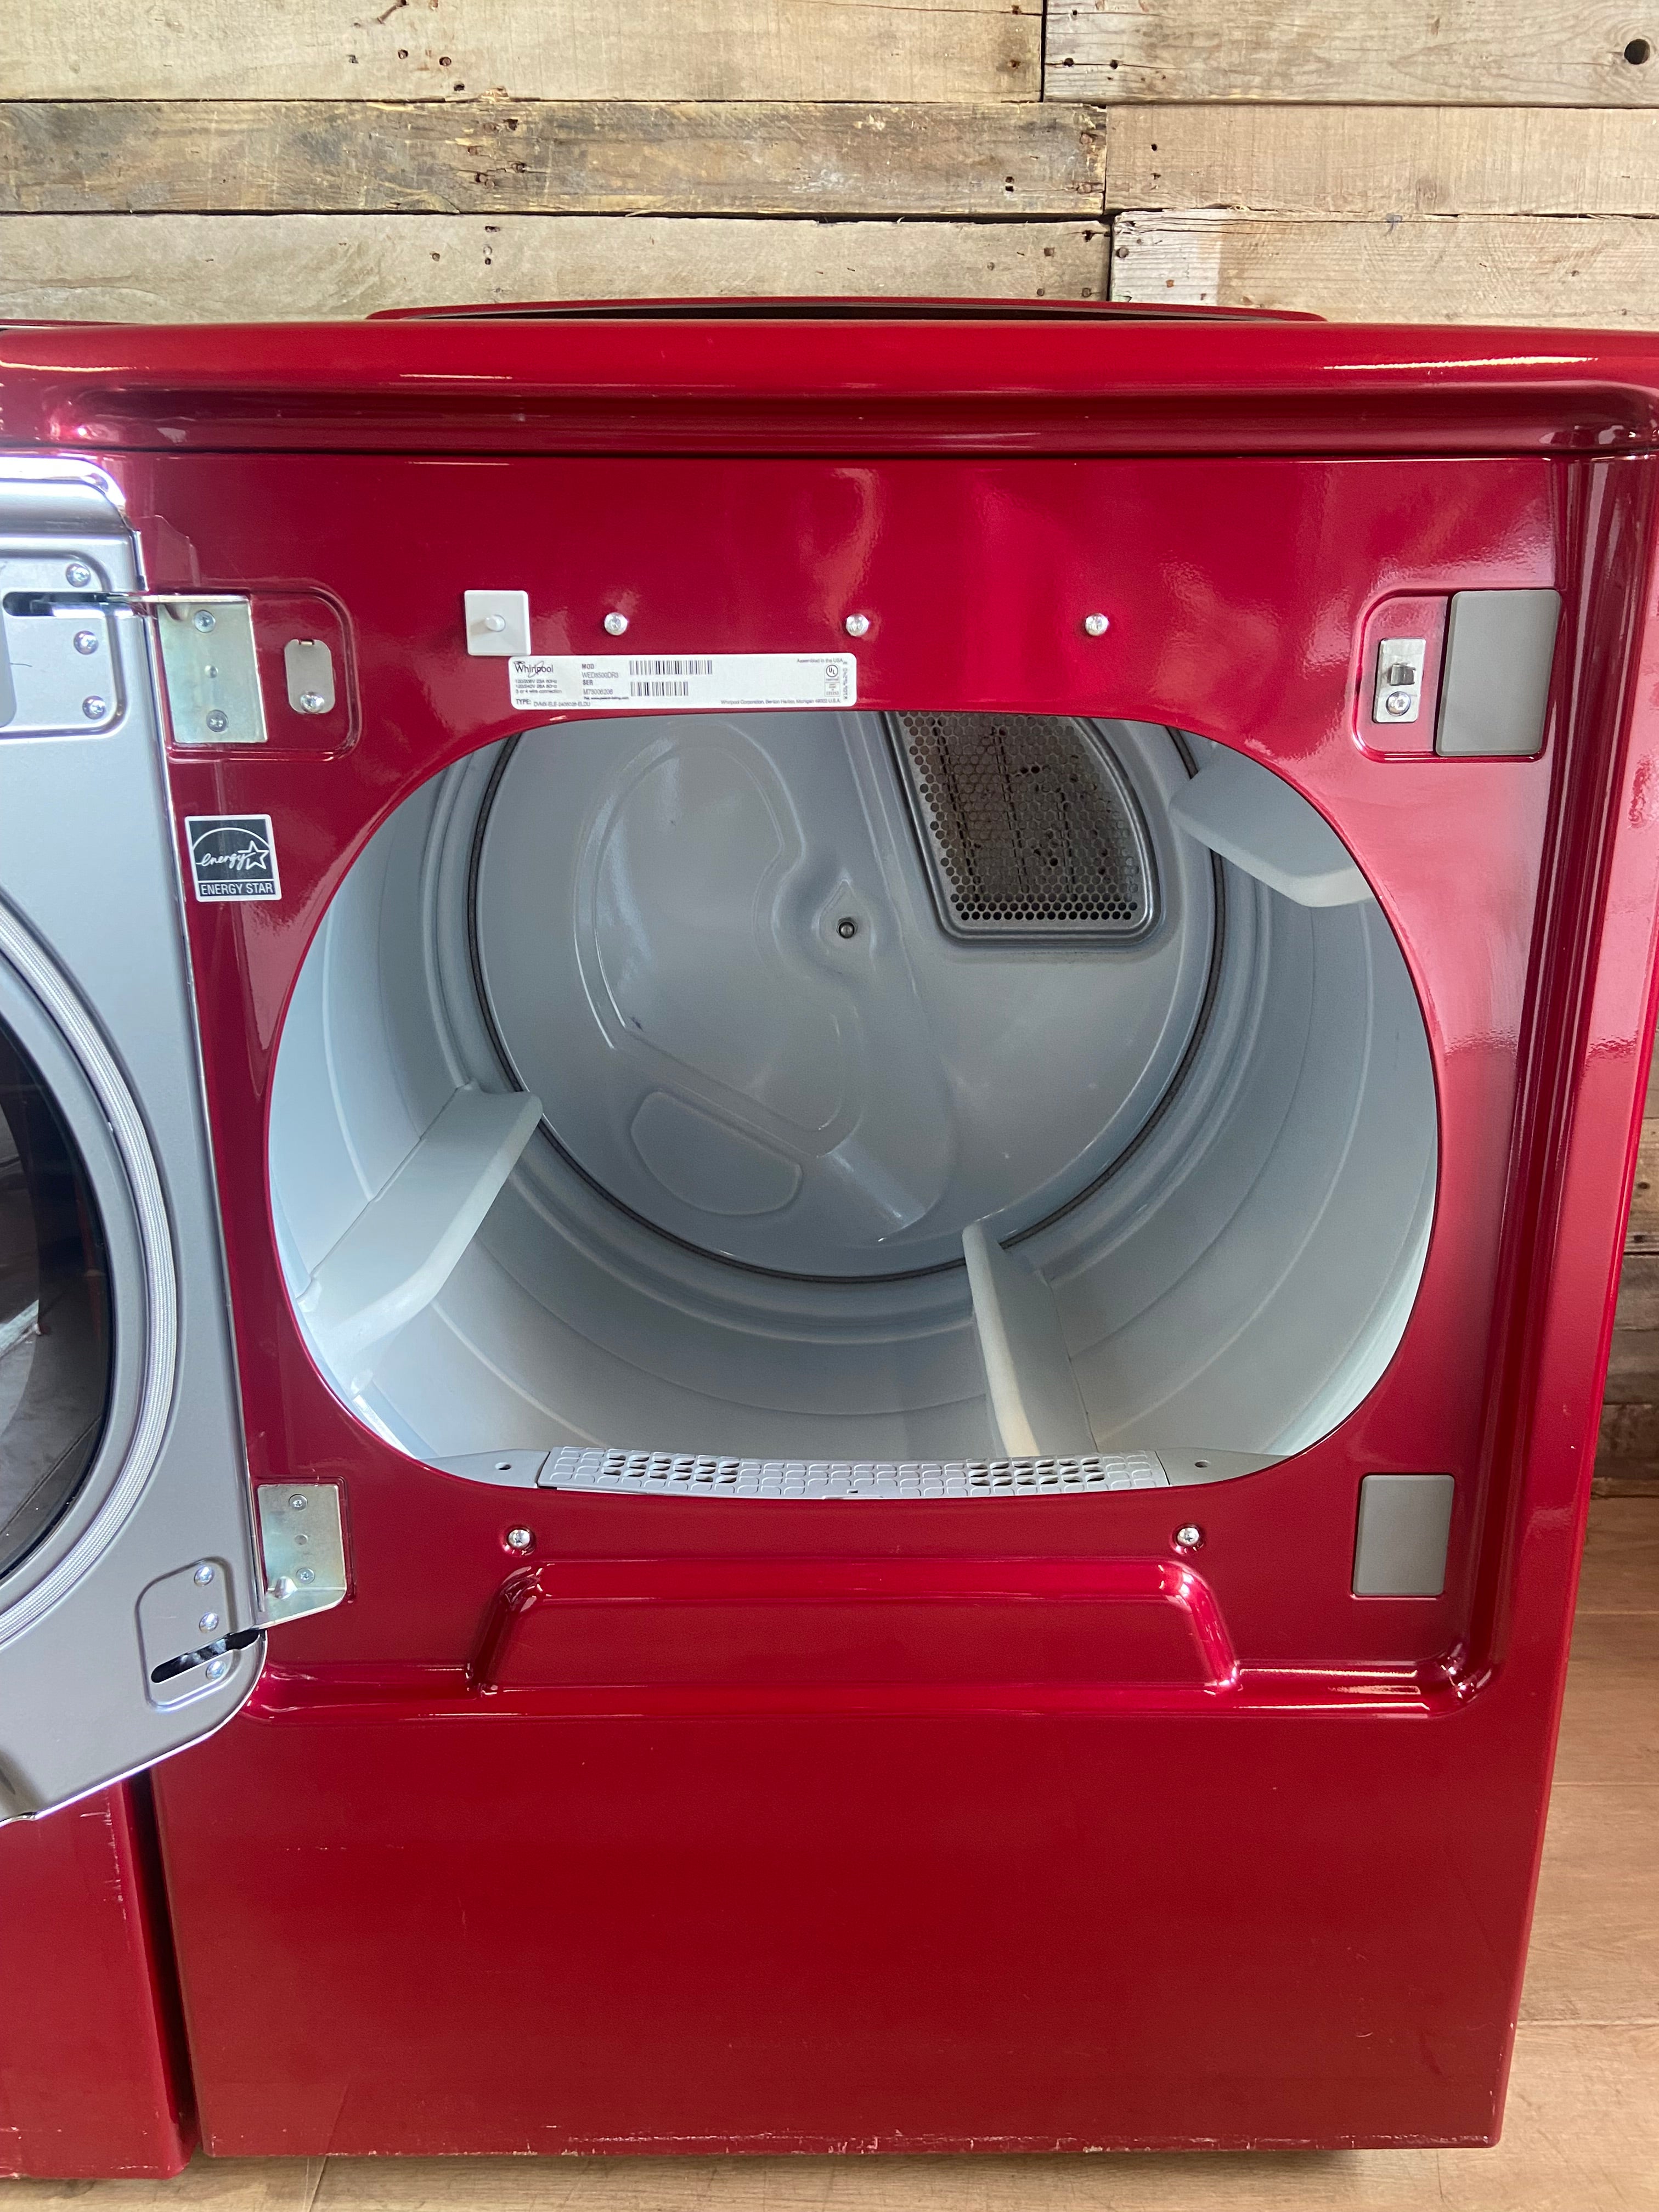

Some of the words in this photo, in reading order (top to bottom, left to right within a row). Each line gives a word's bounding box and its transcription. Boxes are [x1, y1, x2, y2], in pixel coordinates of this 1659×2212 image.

[514, 661, 554, 676] Whirlpool
[196, 853, 255, 871] energy
[200, 883, 243, 895] ENERGY
[246, 882, 274, 895] STAR
